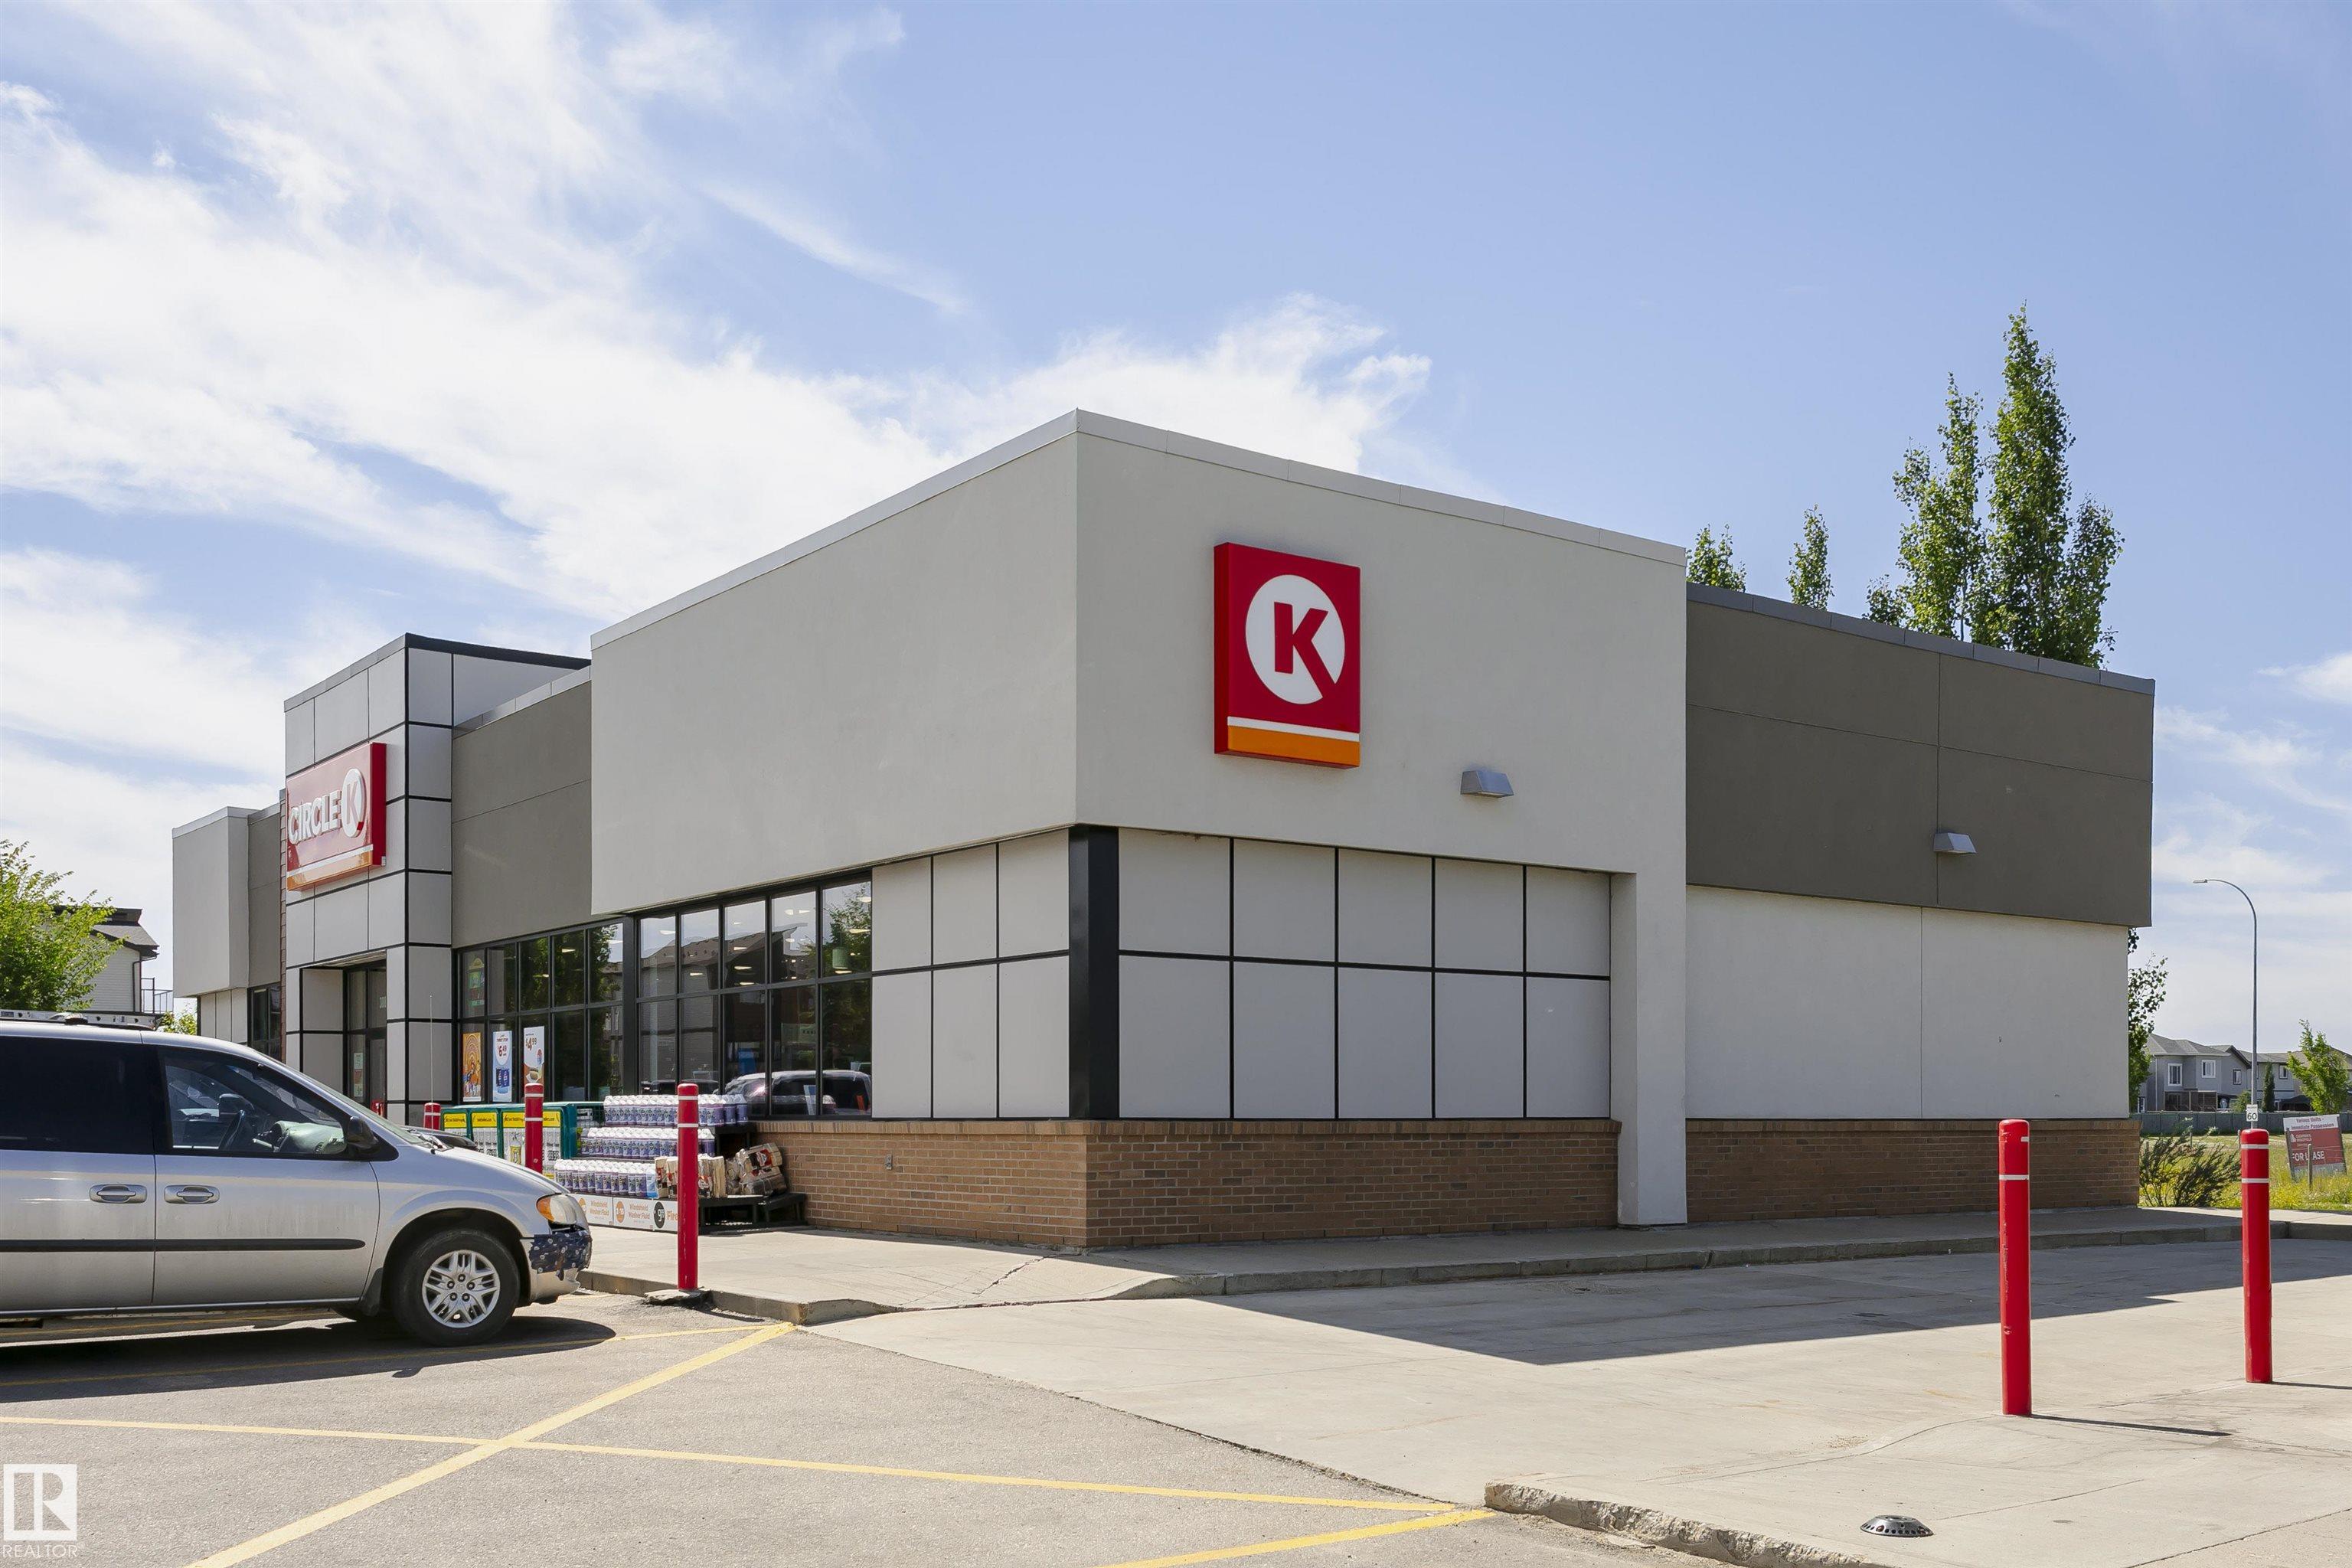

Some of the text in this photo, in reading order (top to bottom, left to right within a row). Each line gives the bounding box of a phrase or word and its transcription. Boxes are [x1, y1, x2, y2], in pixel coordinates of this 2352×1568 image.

[1274, 602, 1335, 697] K
[288, 790, 341, 844] CIRCLE
[2305, 1151, 2324, 1161] LASE
